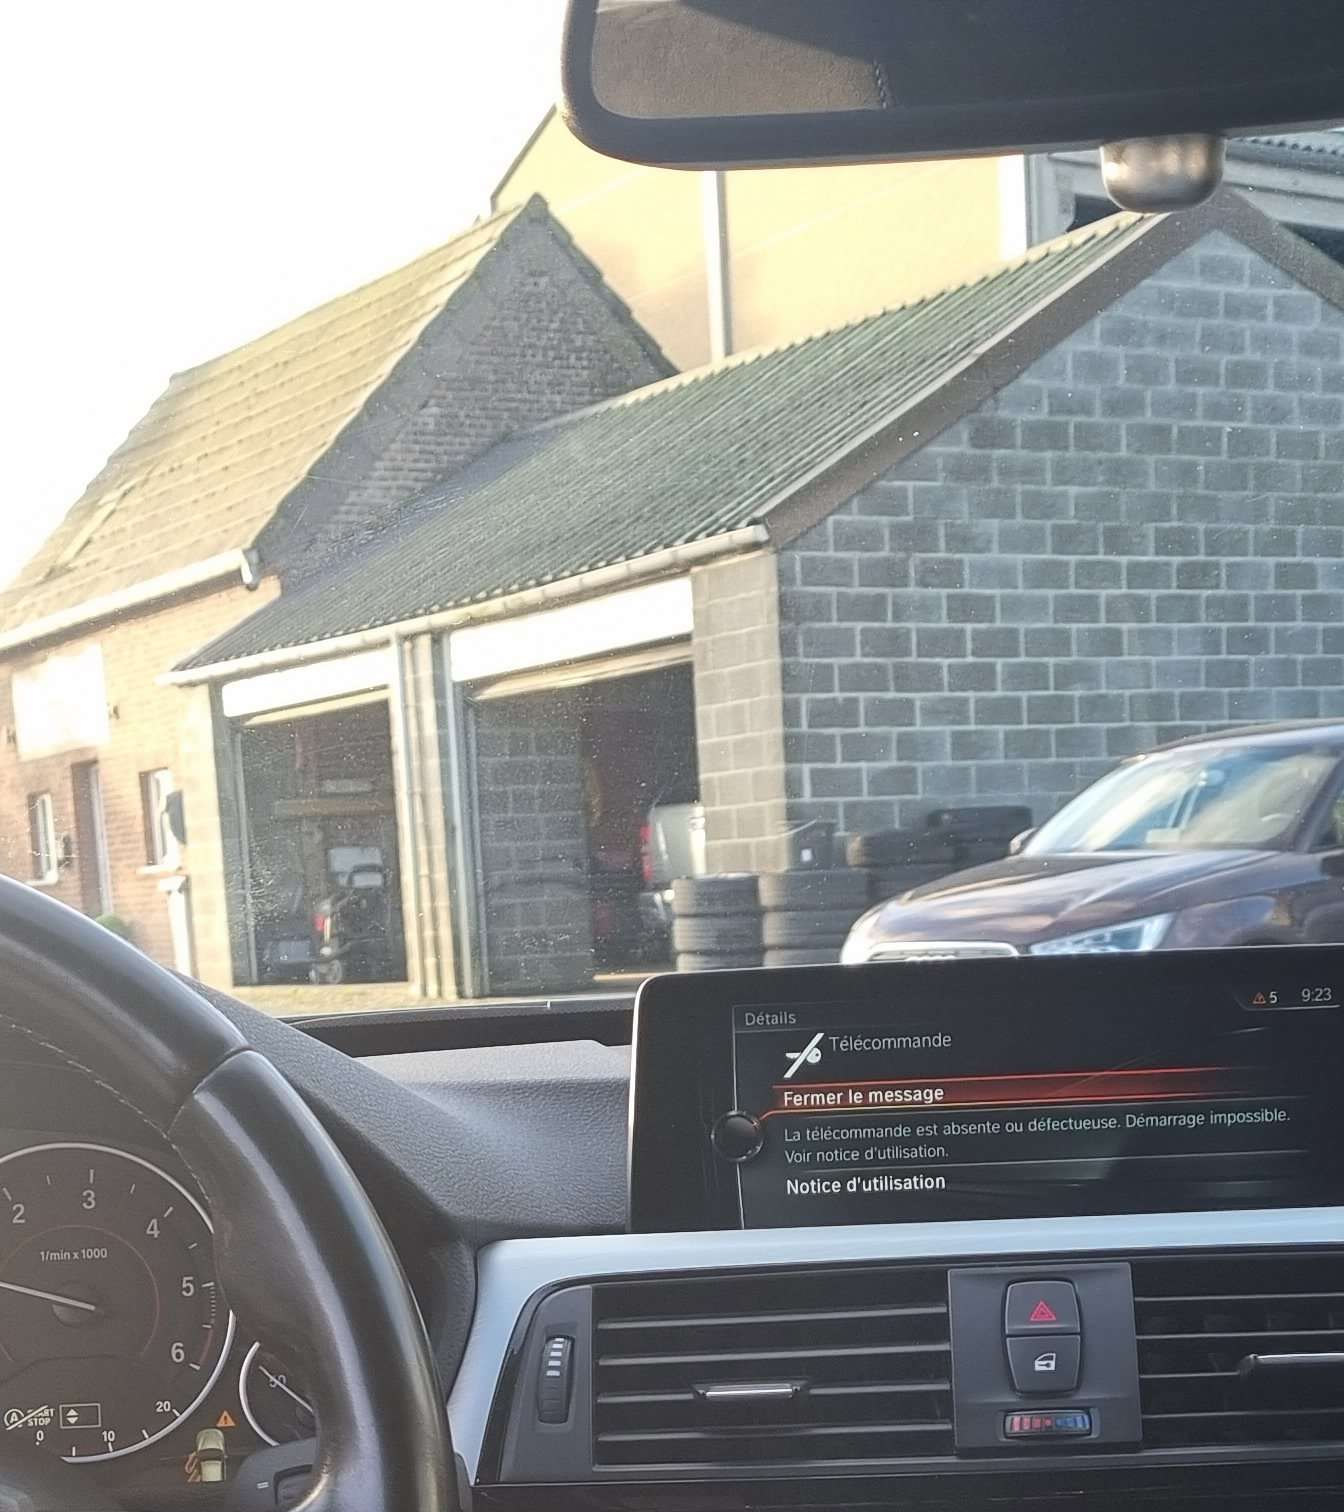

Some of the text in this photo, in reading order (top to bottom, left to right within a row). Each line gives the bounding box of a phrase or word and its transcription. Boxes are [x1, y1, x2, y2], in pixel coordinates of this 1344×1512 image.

[1270, 988, 1332, 1003] 5 9:23
[745, 1011, 796, 1026] Détails
[829, 1033, 952, 1051] Télécommande
[784, 1088, 944, 1107] Fermer le message
[784, 1107, 1291, 1142] La télécommande est absente ou défectueuse. Démarrage impossible.
[785, 1145, 949, 1164] Voir notice d'utilisation.
[786, 1175, 946, 1195] Notice d'utilisation
[82, 1190, 96, 1209] 3
[12, 1204, 26, 1223] 2
[146, 1219, 160, 1237] 4
[40, 1249, 71, 1262] 1/min
[80, 1248, 108, 1259] 1000
[181, 1277, 194, 1296] 5
[171, 1343, 184, 1362] 6
[156, 1401, 171, 1412] 20
[36, 1431, 115, 1441] 0 10
